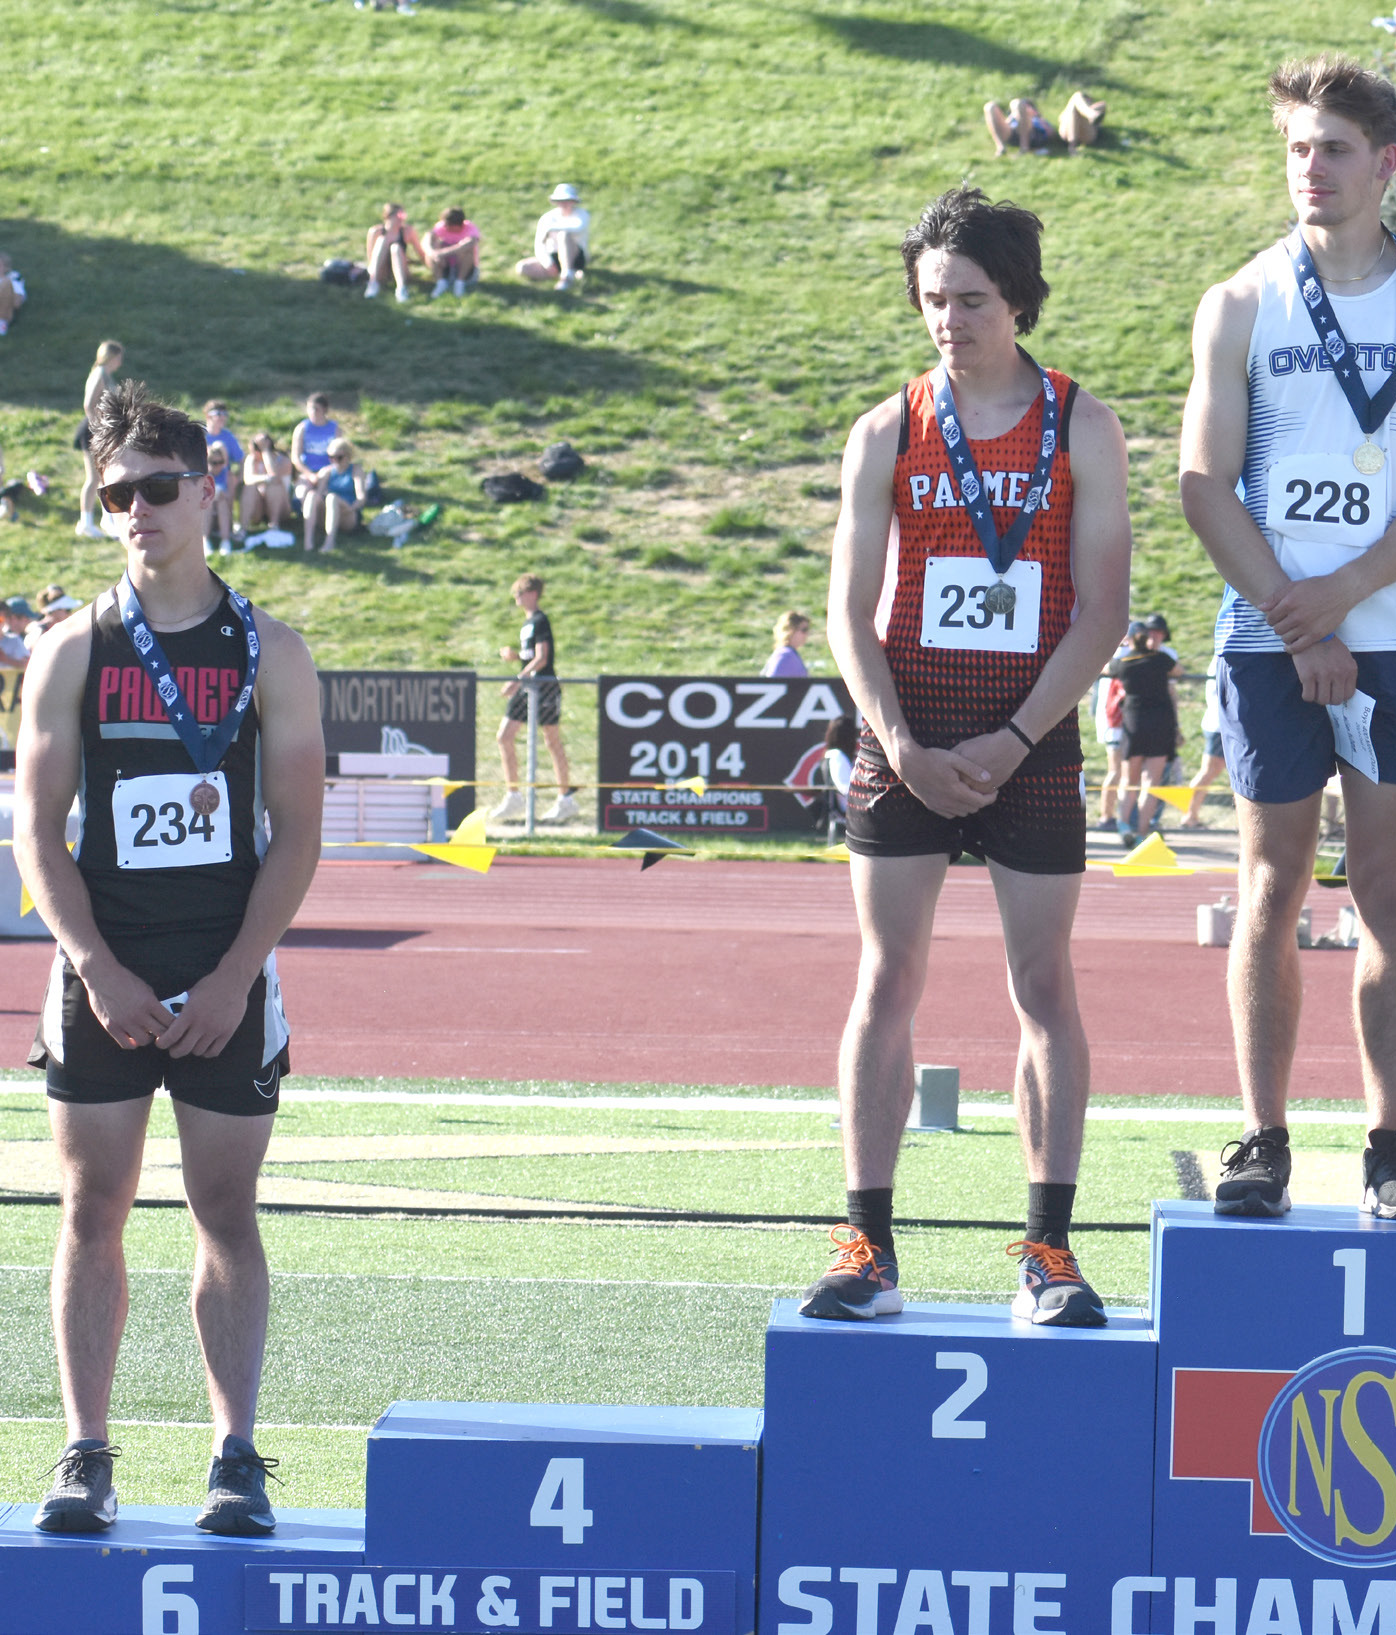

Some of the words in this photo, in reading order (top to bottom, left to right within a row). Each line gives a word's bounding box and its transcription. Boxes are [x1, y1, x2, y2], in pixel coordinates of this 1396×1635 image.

[909, 470, 1053, 511] PAMER
[1285, 479, 1370, 525] 228
[939, 584, 1016, 631] 231
[331, 678, 469, 722] NORTHWEST
[605, 682, 861, 729] COZA
[629, 741, 745, 777] 2014
[612, 791, 661, 805] STATE
[664, 790, 764, 806] CHAMPIONS
[625, 811, 680, 825] TRACK
[685, 812, 697, 825] &
[701, 811, 748, 826] FIELD
[130, 801, 215, 847] 234
[1333, 1248, 1366, 1335] 1
[931, 1352, 988, 1439] 2
[529, 1457, 594, 1544] 4
[142, 1564, 199, 1635] 6
[269, 1572, 456, 1626] TRACK
[477, 1575, 520, 1626] &
[539, 1576, 704, 1630] FIELD
[777, 1566, 1067, 1635] STATE
